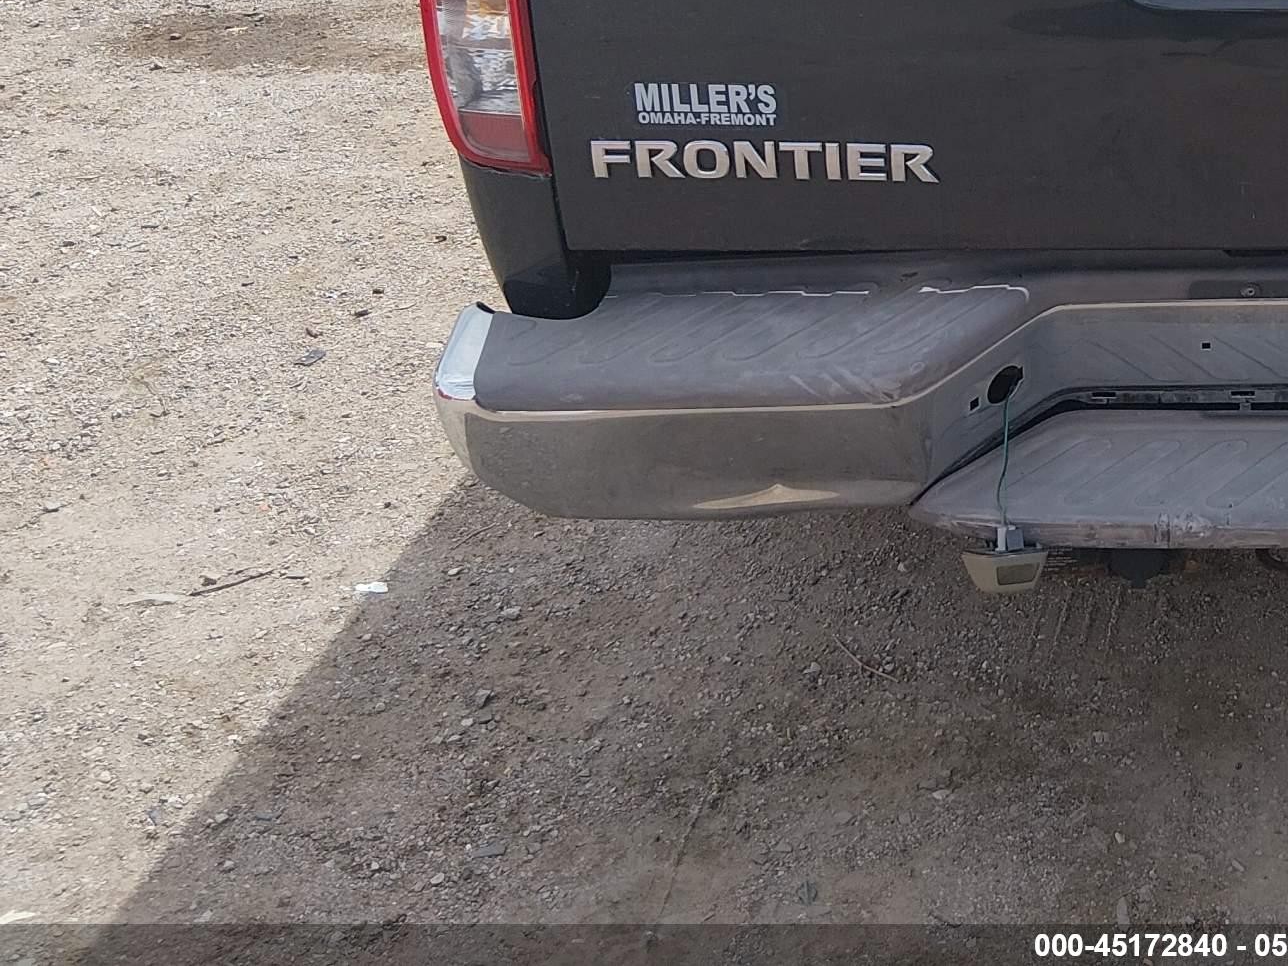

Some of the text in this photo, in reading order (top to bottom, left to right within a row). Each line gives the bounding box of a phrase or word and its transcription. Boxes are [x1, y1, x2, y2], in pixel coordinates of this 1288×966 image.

[634, 82, 778, 114] MILLER'S
[638, 112, 778, 127] OMAHA-FREMONT
[590, 139, 940, 184] FRONTIER
